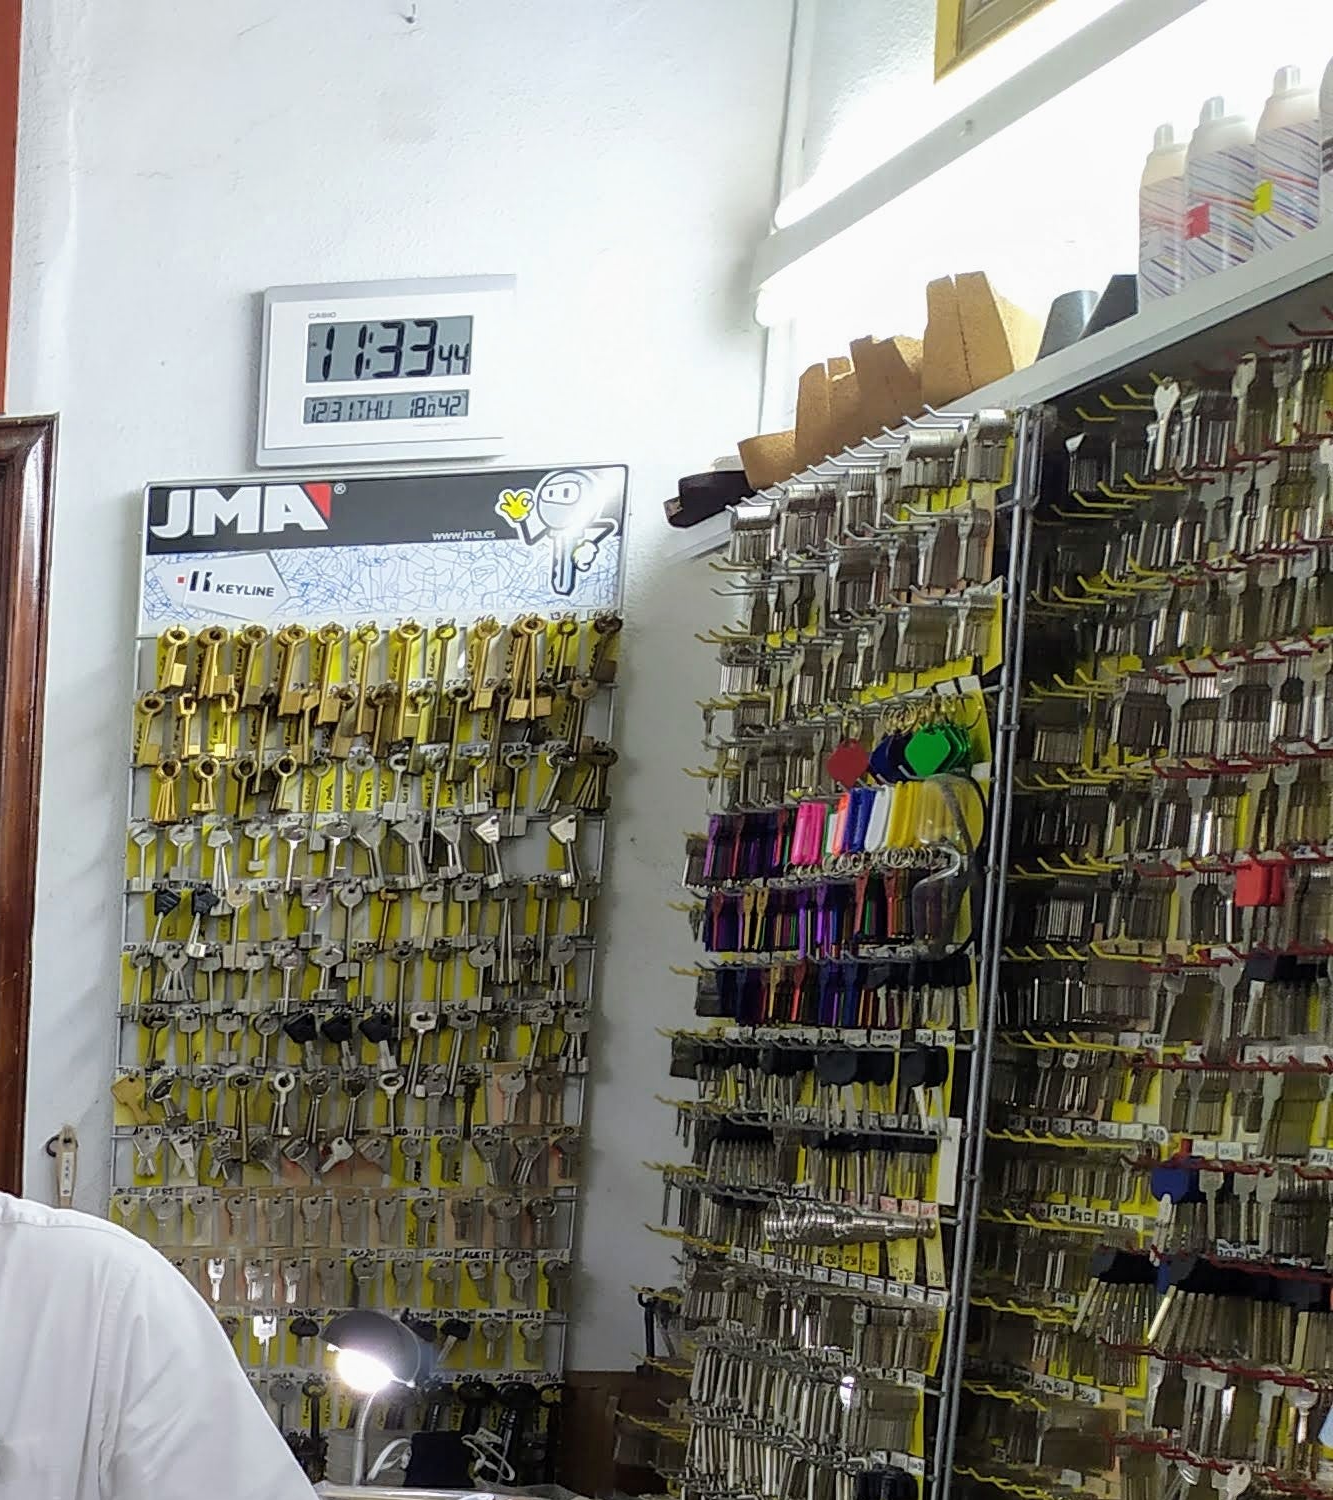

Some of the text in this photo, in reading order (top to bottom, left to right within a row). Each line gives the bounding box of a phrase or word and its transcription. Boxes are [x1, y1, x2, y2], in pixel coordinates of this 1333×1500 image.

[149, 484, 330, 541] JMA
[432, 529, 497, 542] www.jma.es
[215, 582, 275, 599] KEYLINE
